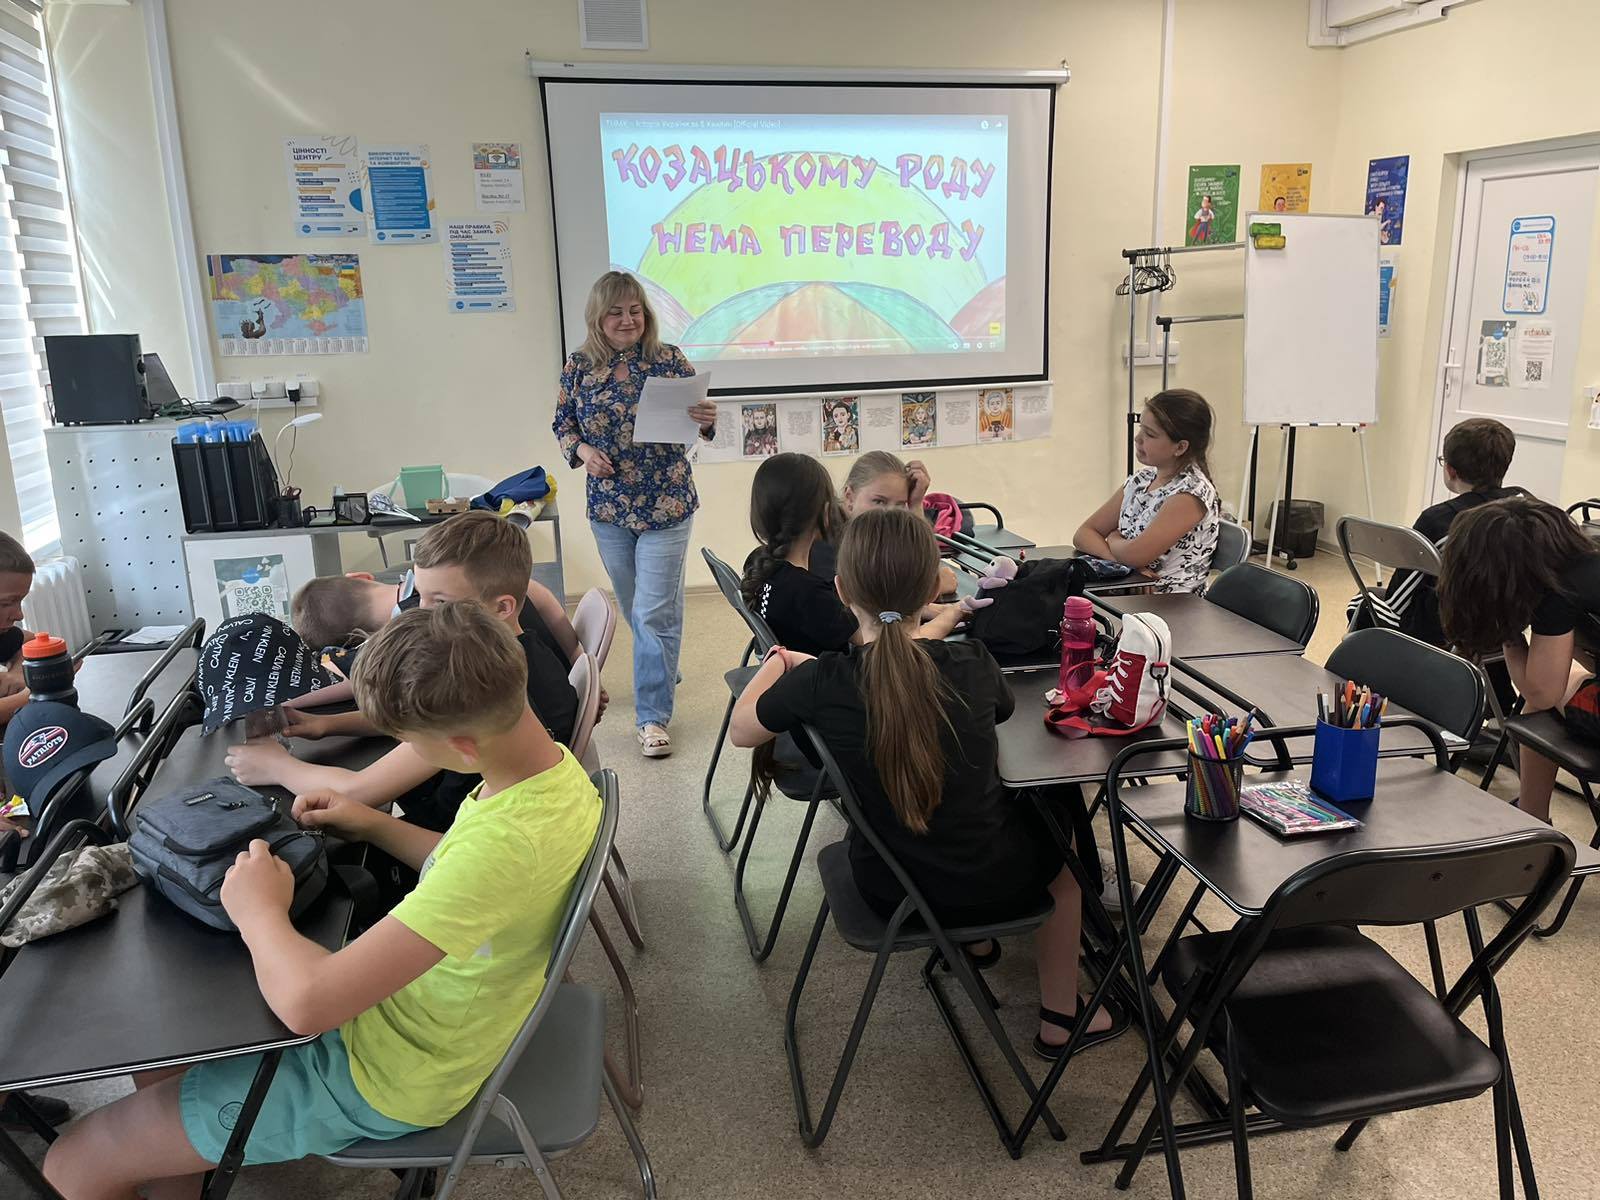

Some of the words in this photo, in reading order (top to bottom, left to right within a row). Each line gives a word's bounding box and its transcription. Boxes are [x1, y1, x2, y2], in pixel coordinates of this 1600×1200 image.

[612, 143, 877, 194] КОЗАЦЬКОМУ
[896, 154, 996, 200] РОДУ
[652, 222, 762, 256] НЕМА
[780, 219, 985, 261] ПЕРЕВОДУ
[226, 651, 242, 680] KLEIN
[27, 735, 64, 765] PATRIOTS
